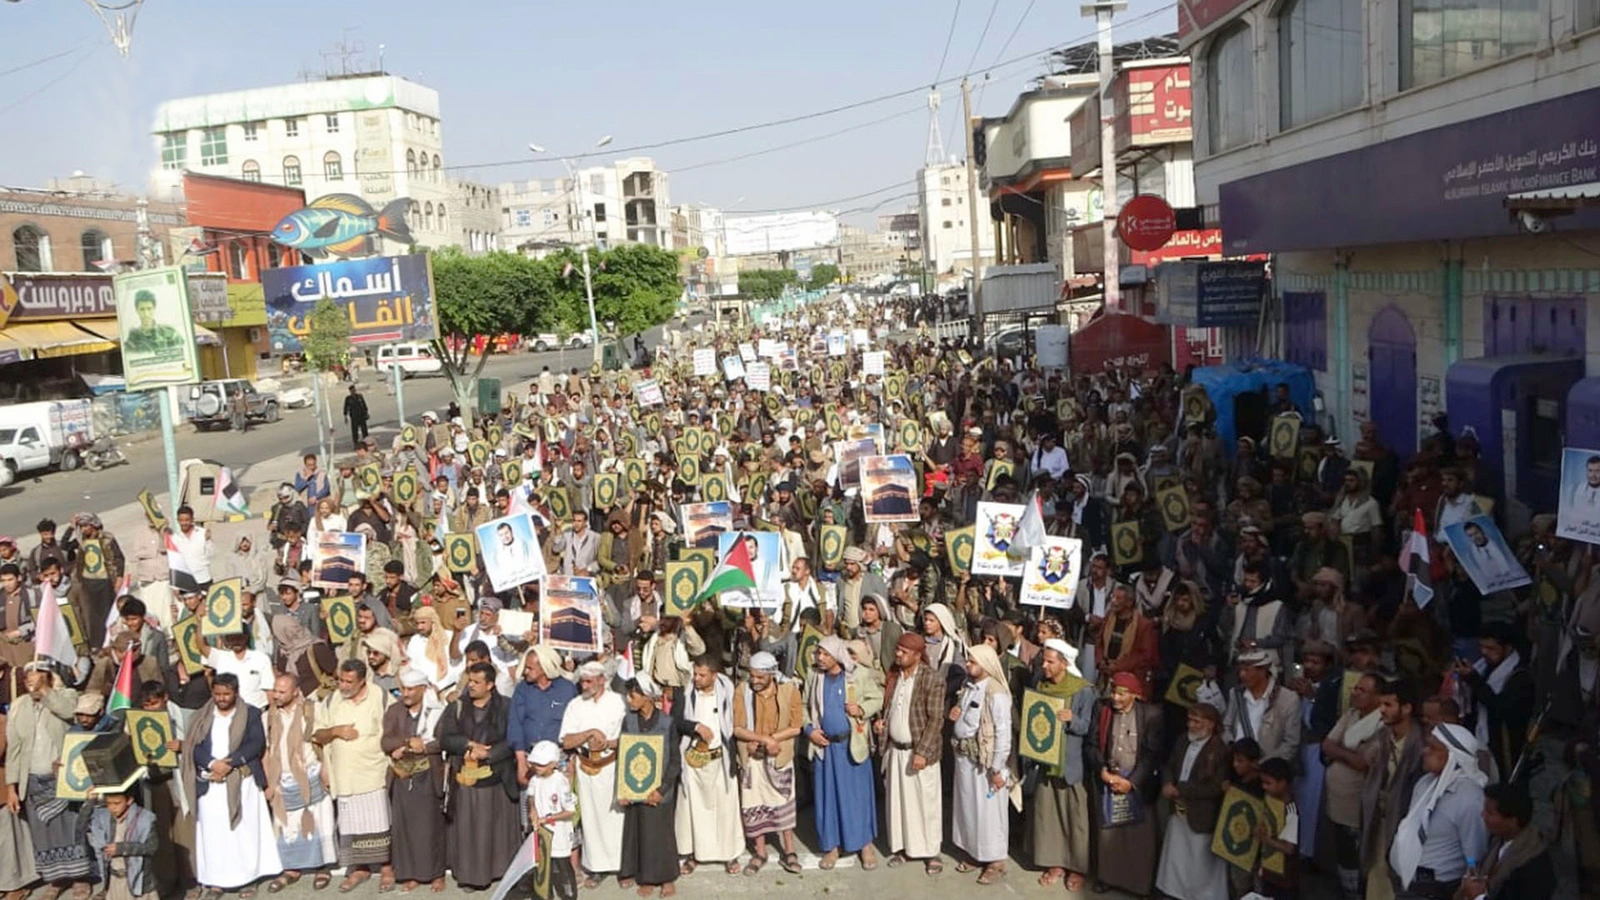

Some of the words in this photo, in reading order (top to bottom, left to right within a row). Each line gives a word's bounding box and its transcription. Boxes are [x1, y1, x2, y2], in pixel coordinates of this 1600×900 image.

[1538, 142, 1577, 169] الكريمي
[1578, 139, 1597, 157] بنك
[1571, 167, 1598, 183] BANK
[291, 258, 403, 302] أسماك
[18, 281, 96, 313] وبروست
[287, 296, 414, 341] القاي
